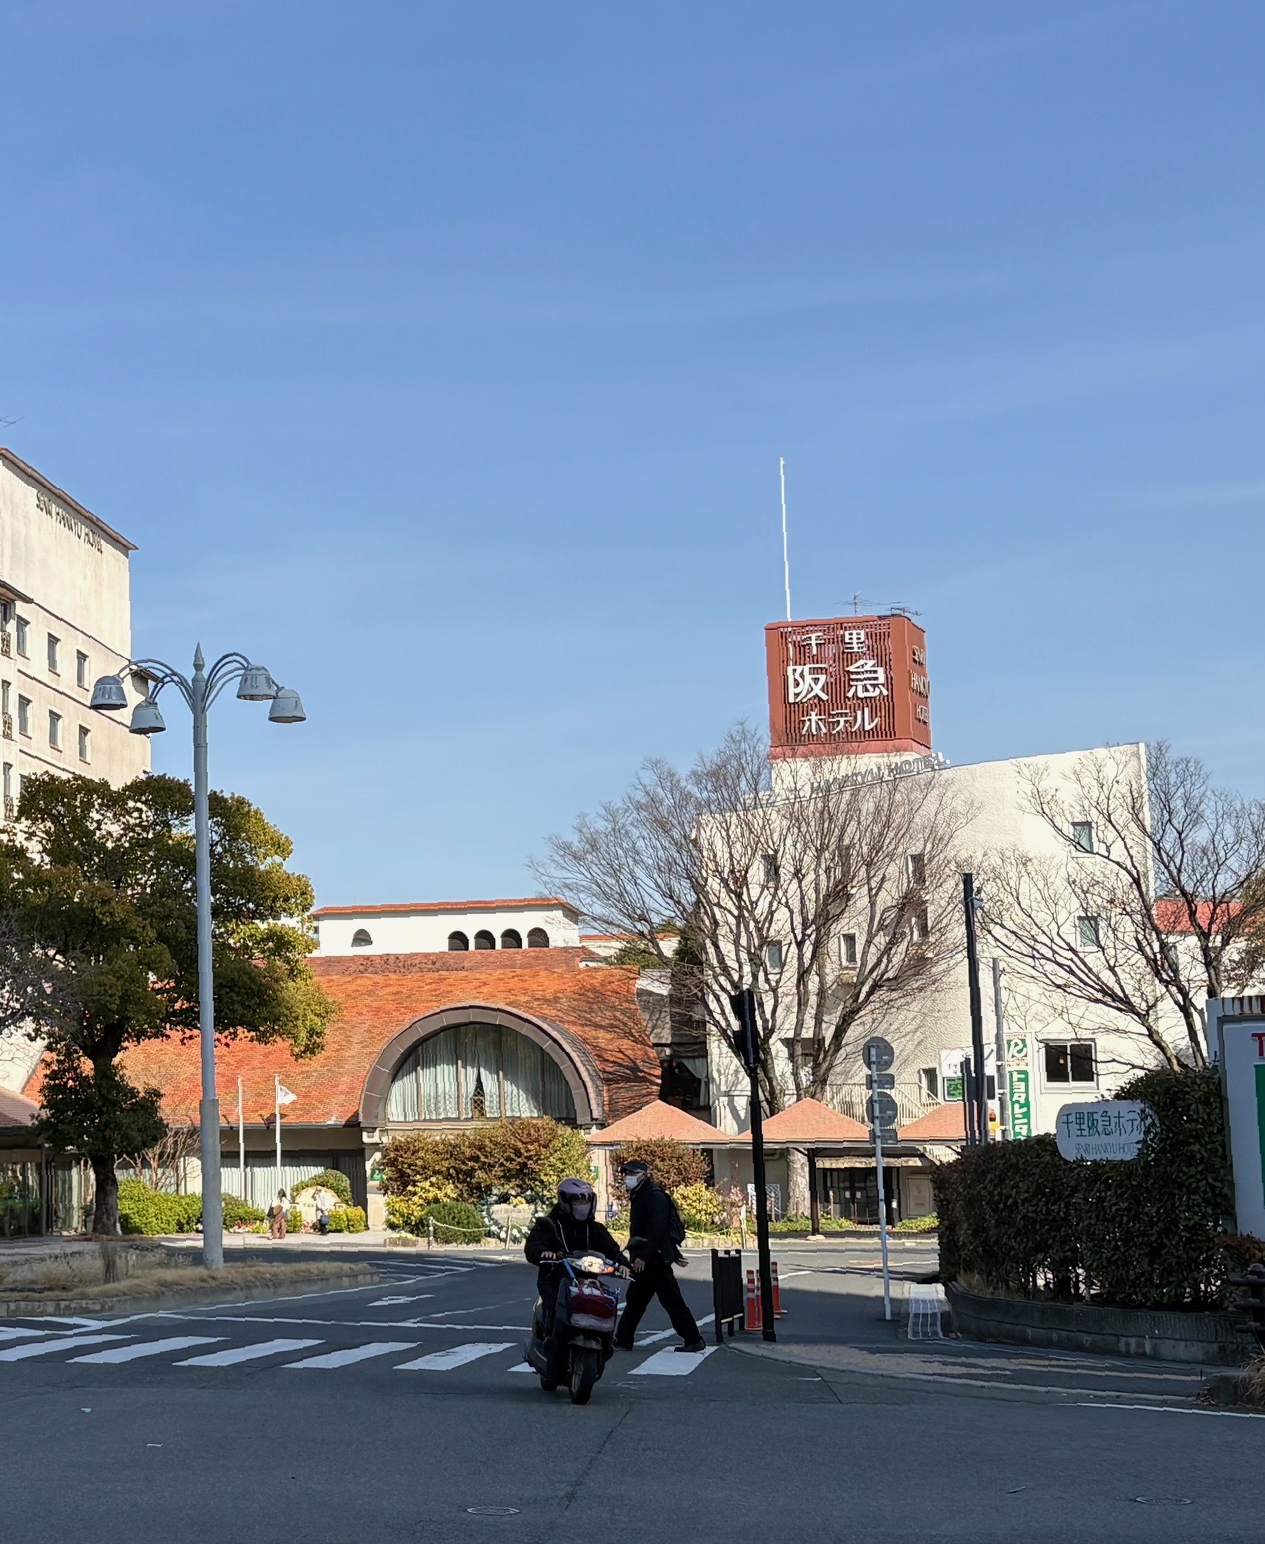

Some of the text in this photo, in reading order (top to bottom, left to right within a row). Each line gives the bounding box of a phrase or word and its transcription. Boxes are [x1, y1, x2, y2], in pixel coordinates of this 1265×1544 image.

[801, 629, 865, 655] 千里
[786, 659, 889, 704] 阪急
[800, 707, 879, 735] ホテル
[1012, 1071, 1028, 1140] トヨタレンタ
